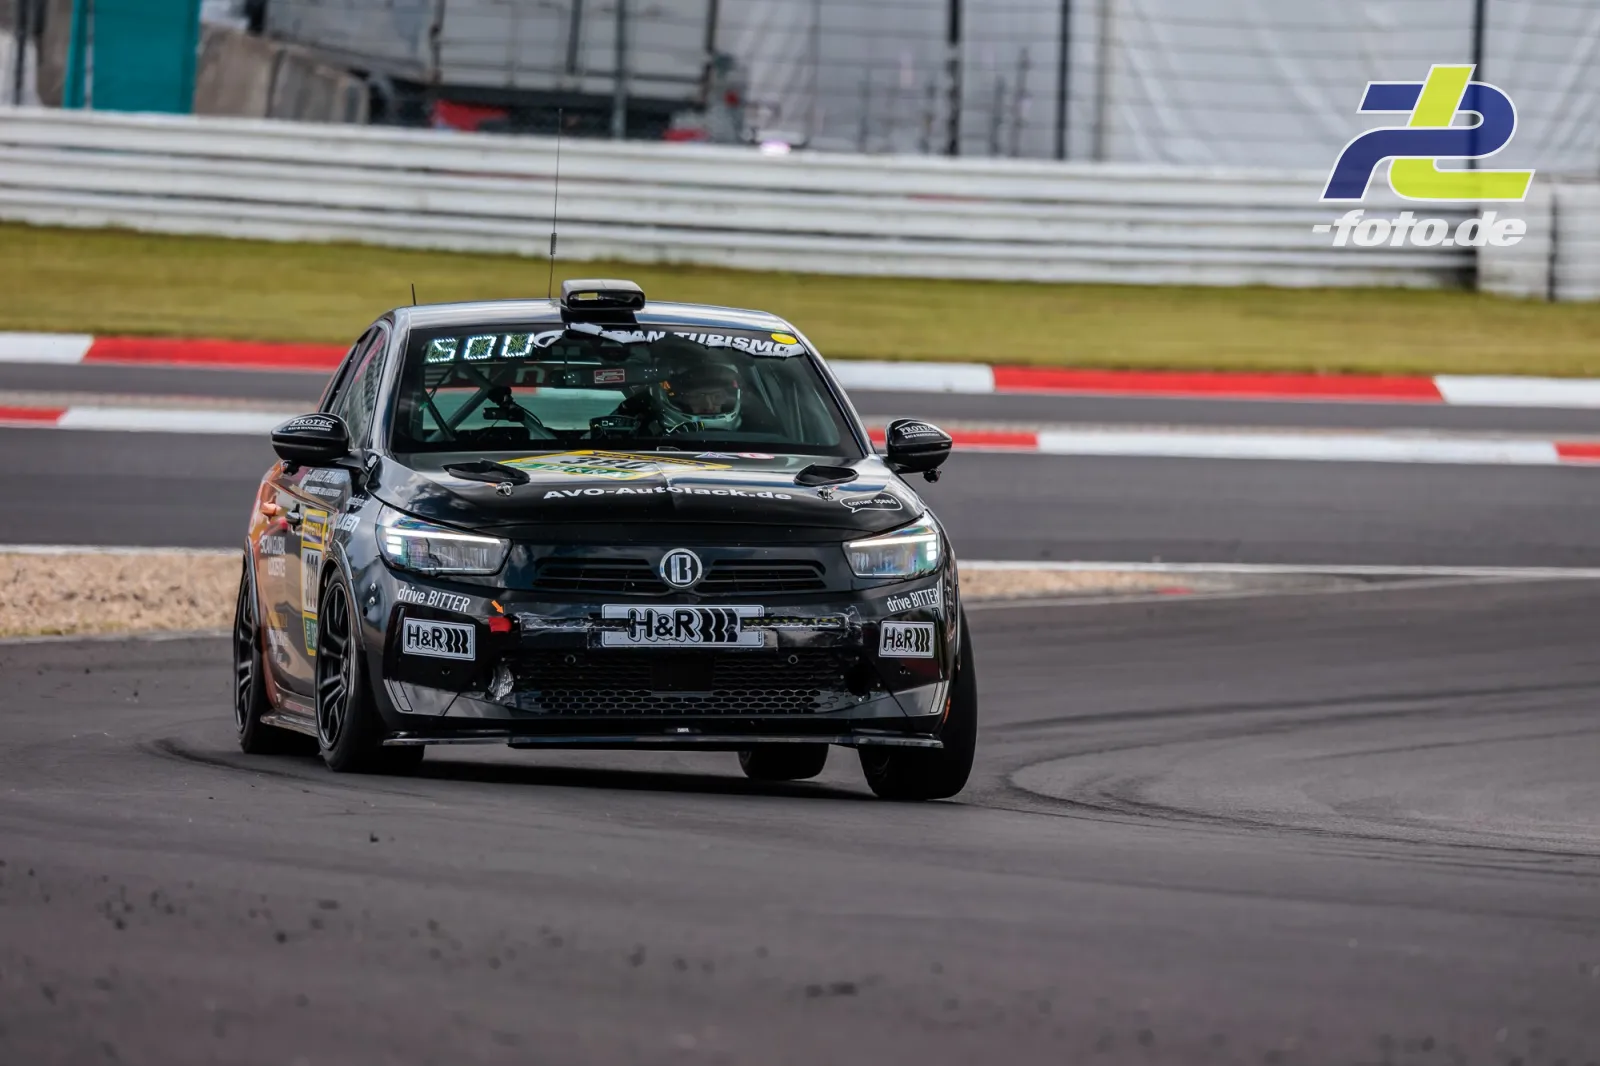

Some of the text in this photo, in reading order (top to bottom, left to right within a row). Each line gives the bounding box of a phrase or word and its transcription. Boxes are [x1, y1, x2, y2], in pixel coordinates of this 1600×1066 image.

[290, 419, 334, 427] PROTEC
[543, 487, 793, 500] AVO-Autolack.de
[397, 585, 471, 613] drive BITTER
[886, 588, 940, 612] drive BITTER
[406, 623, 447, 652] H&R
[627, 607, 701, 643] H&R
[883, 626, 915, 652] H&R
